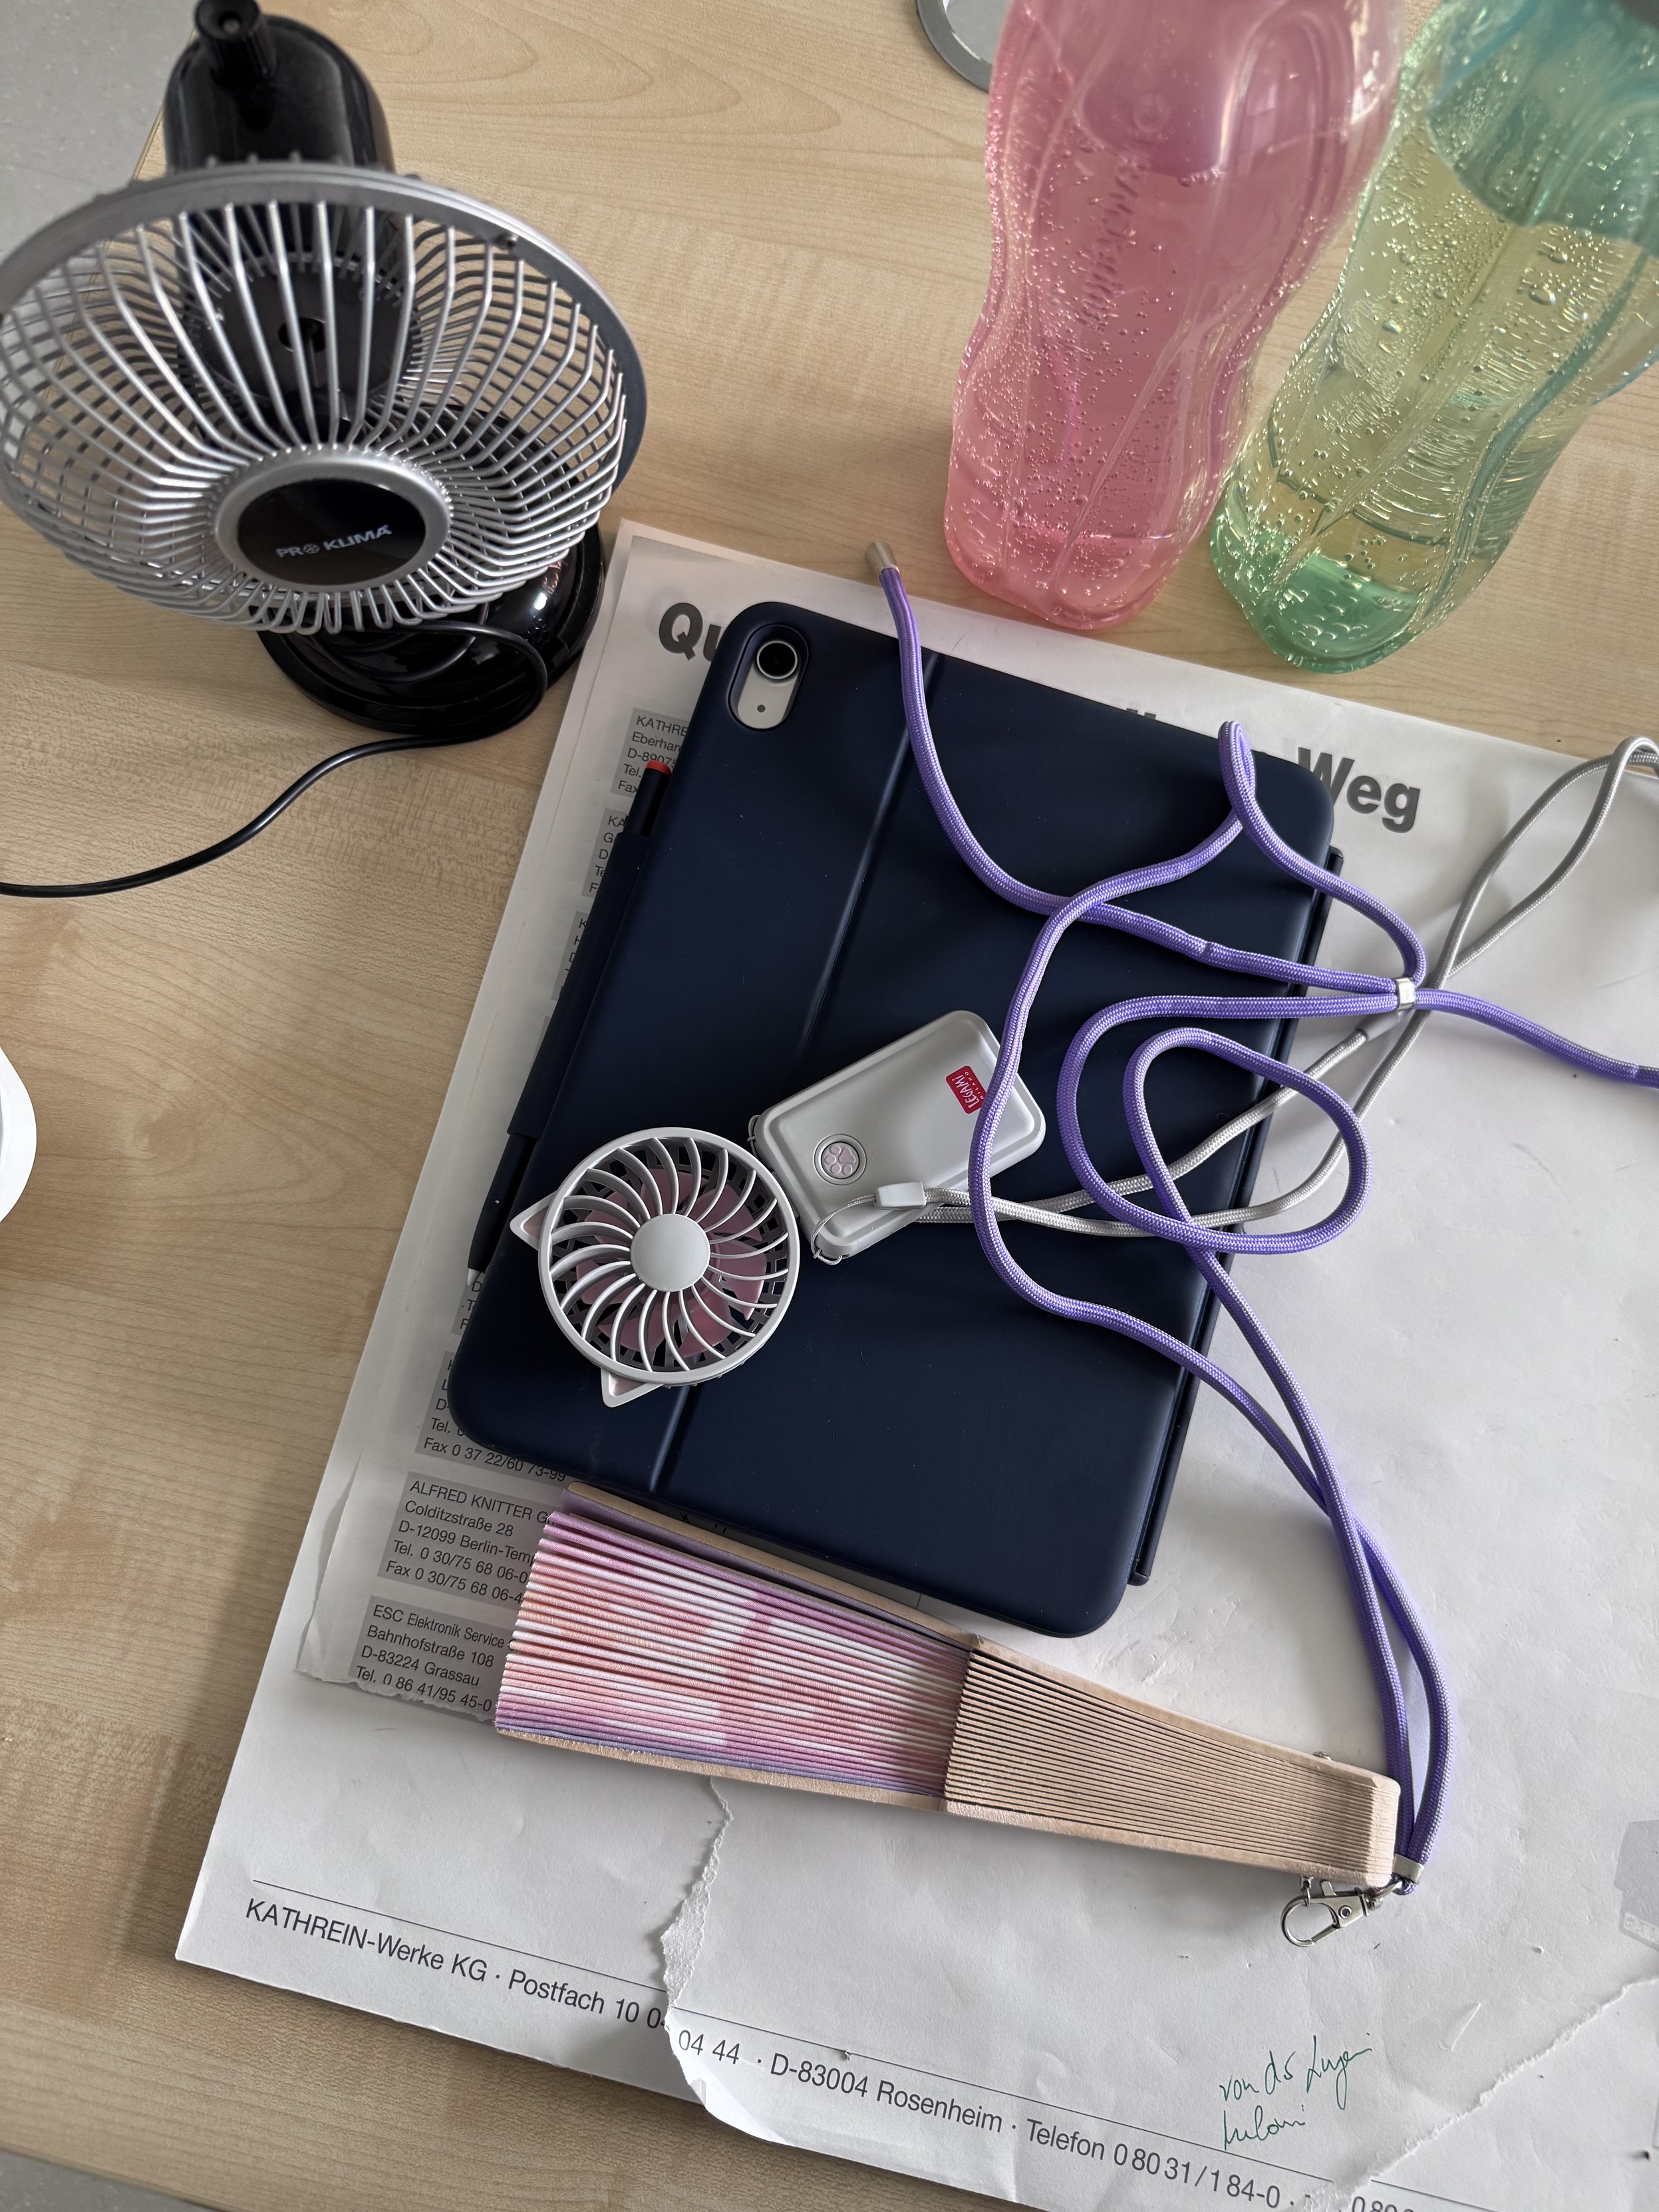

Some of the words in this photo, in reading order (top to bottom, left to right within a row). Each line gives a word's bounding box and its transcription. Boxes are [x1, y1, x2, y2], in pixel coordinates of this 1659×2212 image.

[323, 524, 392, 550] KLIMA
[632, 732, 681, 752] Eberhar
[618, 780, 639, 794] Fax
[624, 764, 641, 778] Tel.
[431, 1418, 450, 1433] Tel.
[424, 1437, 448, 1453] Fax
[464, 1448, 482, 1461] 37
[410, 1480, 467, 1503] ALFRED
[471, 1494, 533, 1520] KNITTER
[398, 1519, 456, 1544] D-12099
[405, 1500, 492, 1531] Colditzstraße
[496, 1523, 514, 1537] 28
[394, 1539, 413, 1556] Tel.
[433, 1550, 472, 1569] 30/75
[476, 1561, 493, 1575] 68
[386, 1560, 411, 1577] Fax
[428, 1571, 467, 1590] 30/75
[470, 1581, 488, 1595] 68
[373, 1604, 404, 1623] ESC
[407, 1613, 462, 1637] Elektronik
[464, 1627, 505, 1649] Service
[367, 1625, 465, 1660] Bahnhofstraße
[471, 1651, 495, 1667] 108
[361, 1645, 419, 1671] D-83224
[424, 1661, 480, 1686] Grassau
[357, 1665, 376, 1682] Tel.
[396, 1676, 414, 1691] 86
[417, 1682, 456, 1703] 41/95
[460, 1693, 492, 1712] 45-0
[246, 1897, 444, 1970] KATHREIN-Werke
[451, 1954, 488, 1982] KG
[509, 1969, 605, 2014] Postfach
[615, 1998, 640, 2022] 10
[679, 2030, 704, 2056] 04
[712, 2039, 740, 2064] 44
[770, 2052, 869, 2098] D-83004
[877, 2079, 1002, 2133] Rosenheim
[1026, 2118, 1105, 2160] Telefon
